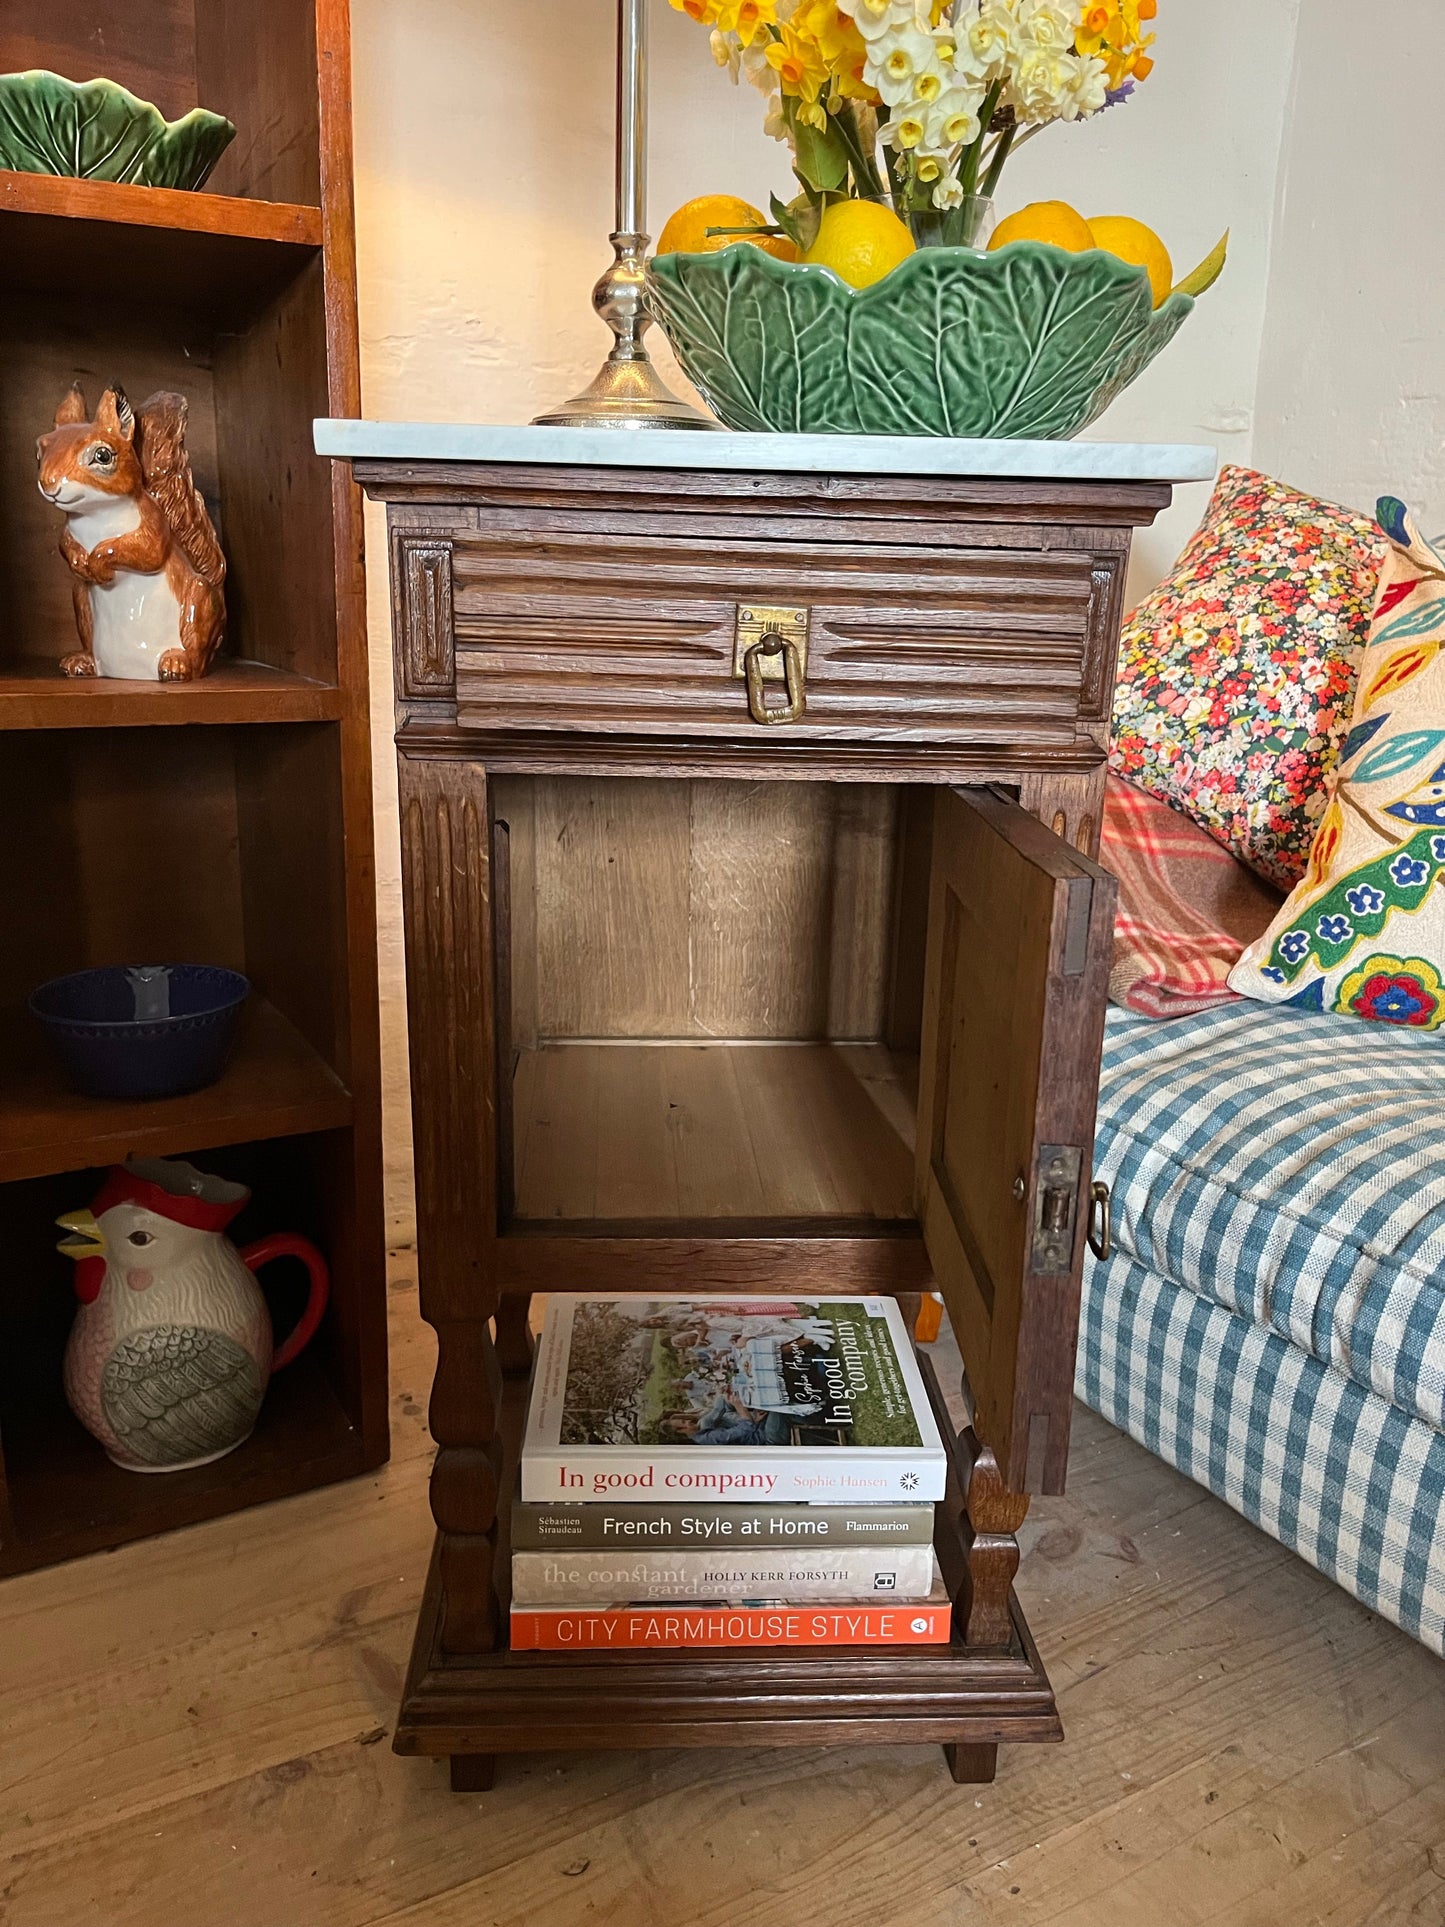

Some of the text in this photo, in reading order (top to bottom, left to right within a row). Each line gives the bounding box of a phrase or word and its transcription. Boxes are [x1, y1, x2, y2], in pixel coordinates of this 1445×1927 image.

[835, 1318, 868, 1391] company
[794, 1373, 822, 1402] Sophie
[811, 1358, 856, 1424] In good
[559, 1466, 887, 1494] In good company Sophie Hansen
[538, 1516, 580, 1526] Sébastien
[538, 1525, 582, 1534] Siraudeau
[604, 1518, 829, 1538] French Style at Home
[846, 1521, 909, 1531] Flammarion
[544, 1564, 687, 1583] the constant
[704, 1571, 848, 1582] HOLLY KERR FORSYTH
[647, 1579, 752, 1598] gardener
[557, 1619, 618, 1642] CITY
[630, 1616, 800, 1640] FARMHOUSE
[811, 1615, 895, 1638] STYLE
